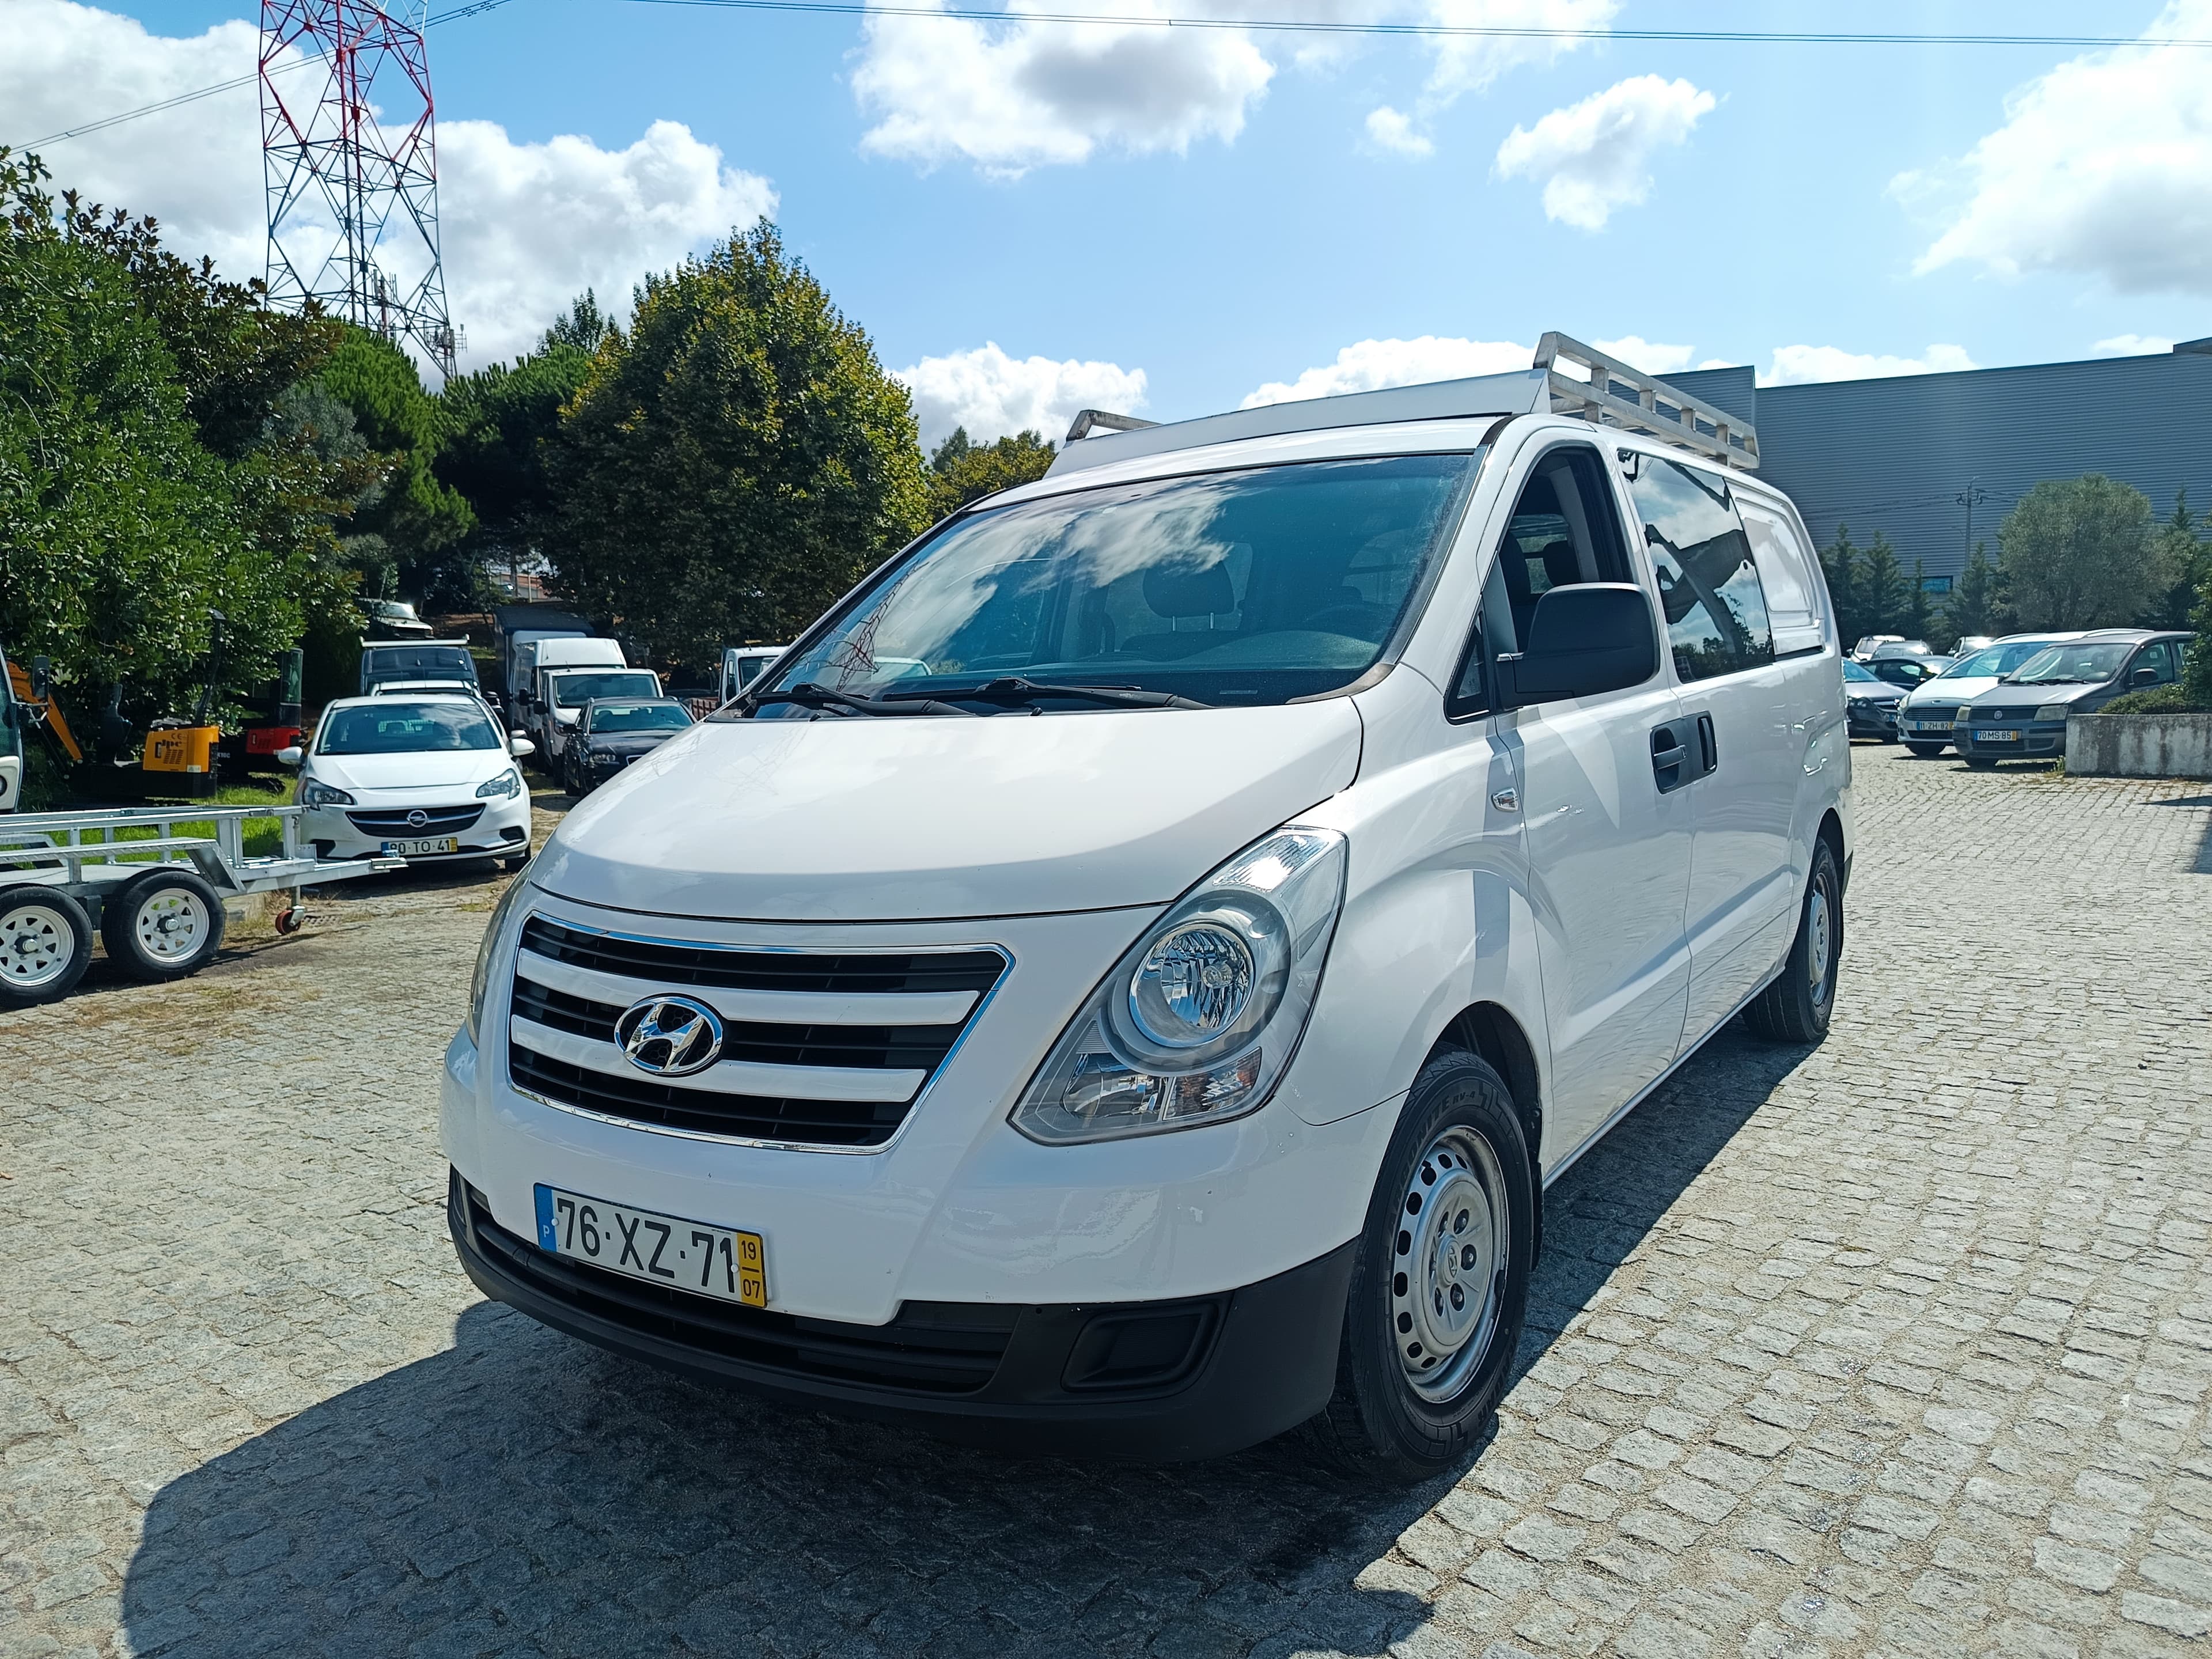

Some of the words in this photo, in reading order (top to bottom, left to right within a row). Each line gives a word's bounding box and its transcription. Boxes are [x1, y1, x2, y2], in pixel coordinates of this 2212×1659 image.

[543, 1225, 550, 1238] P
[741, 1240, 757, 1261] 19
[743, 1278, 760, 1300] 07
